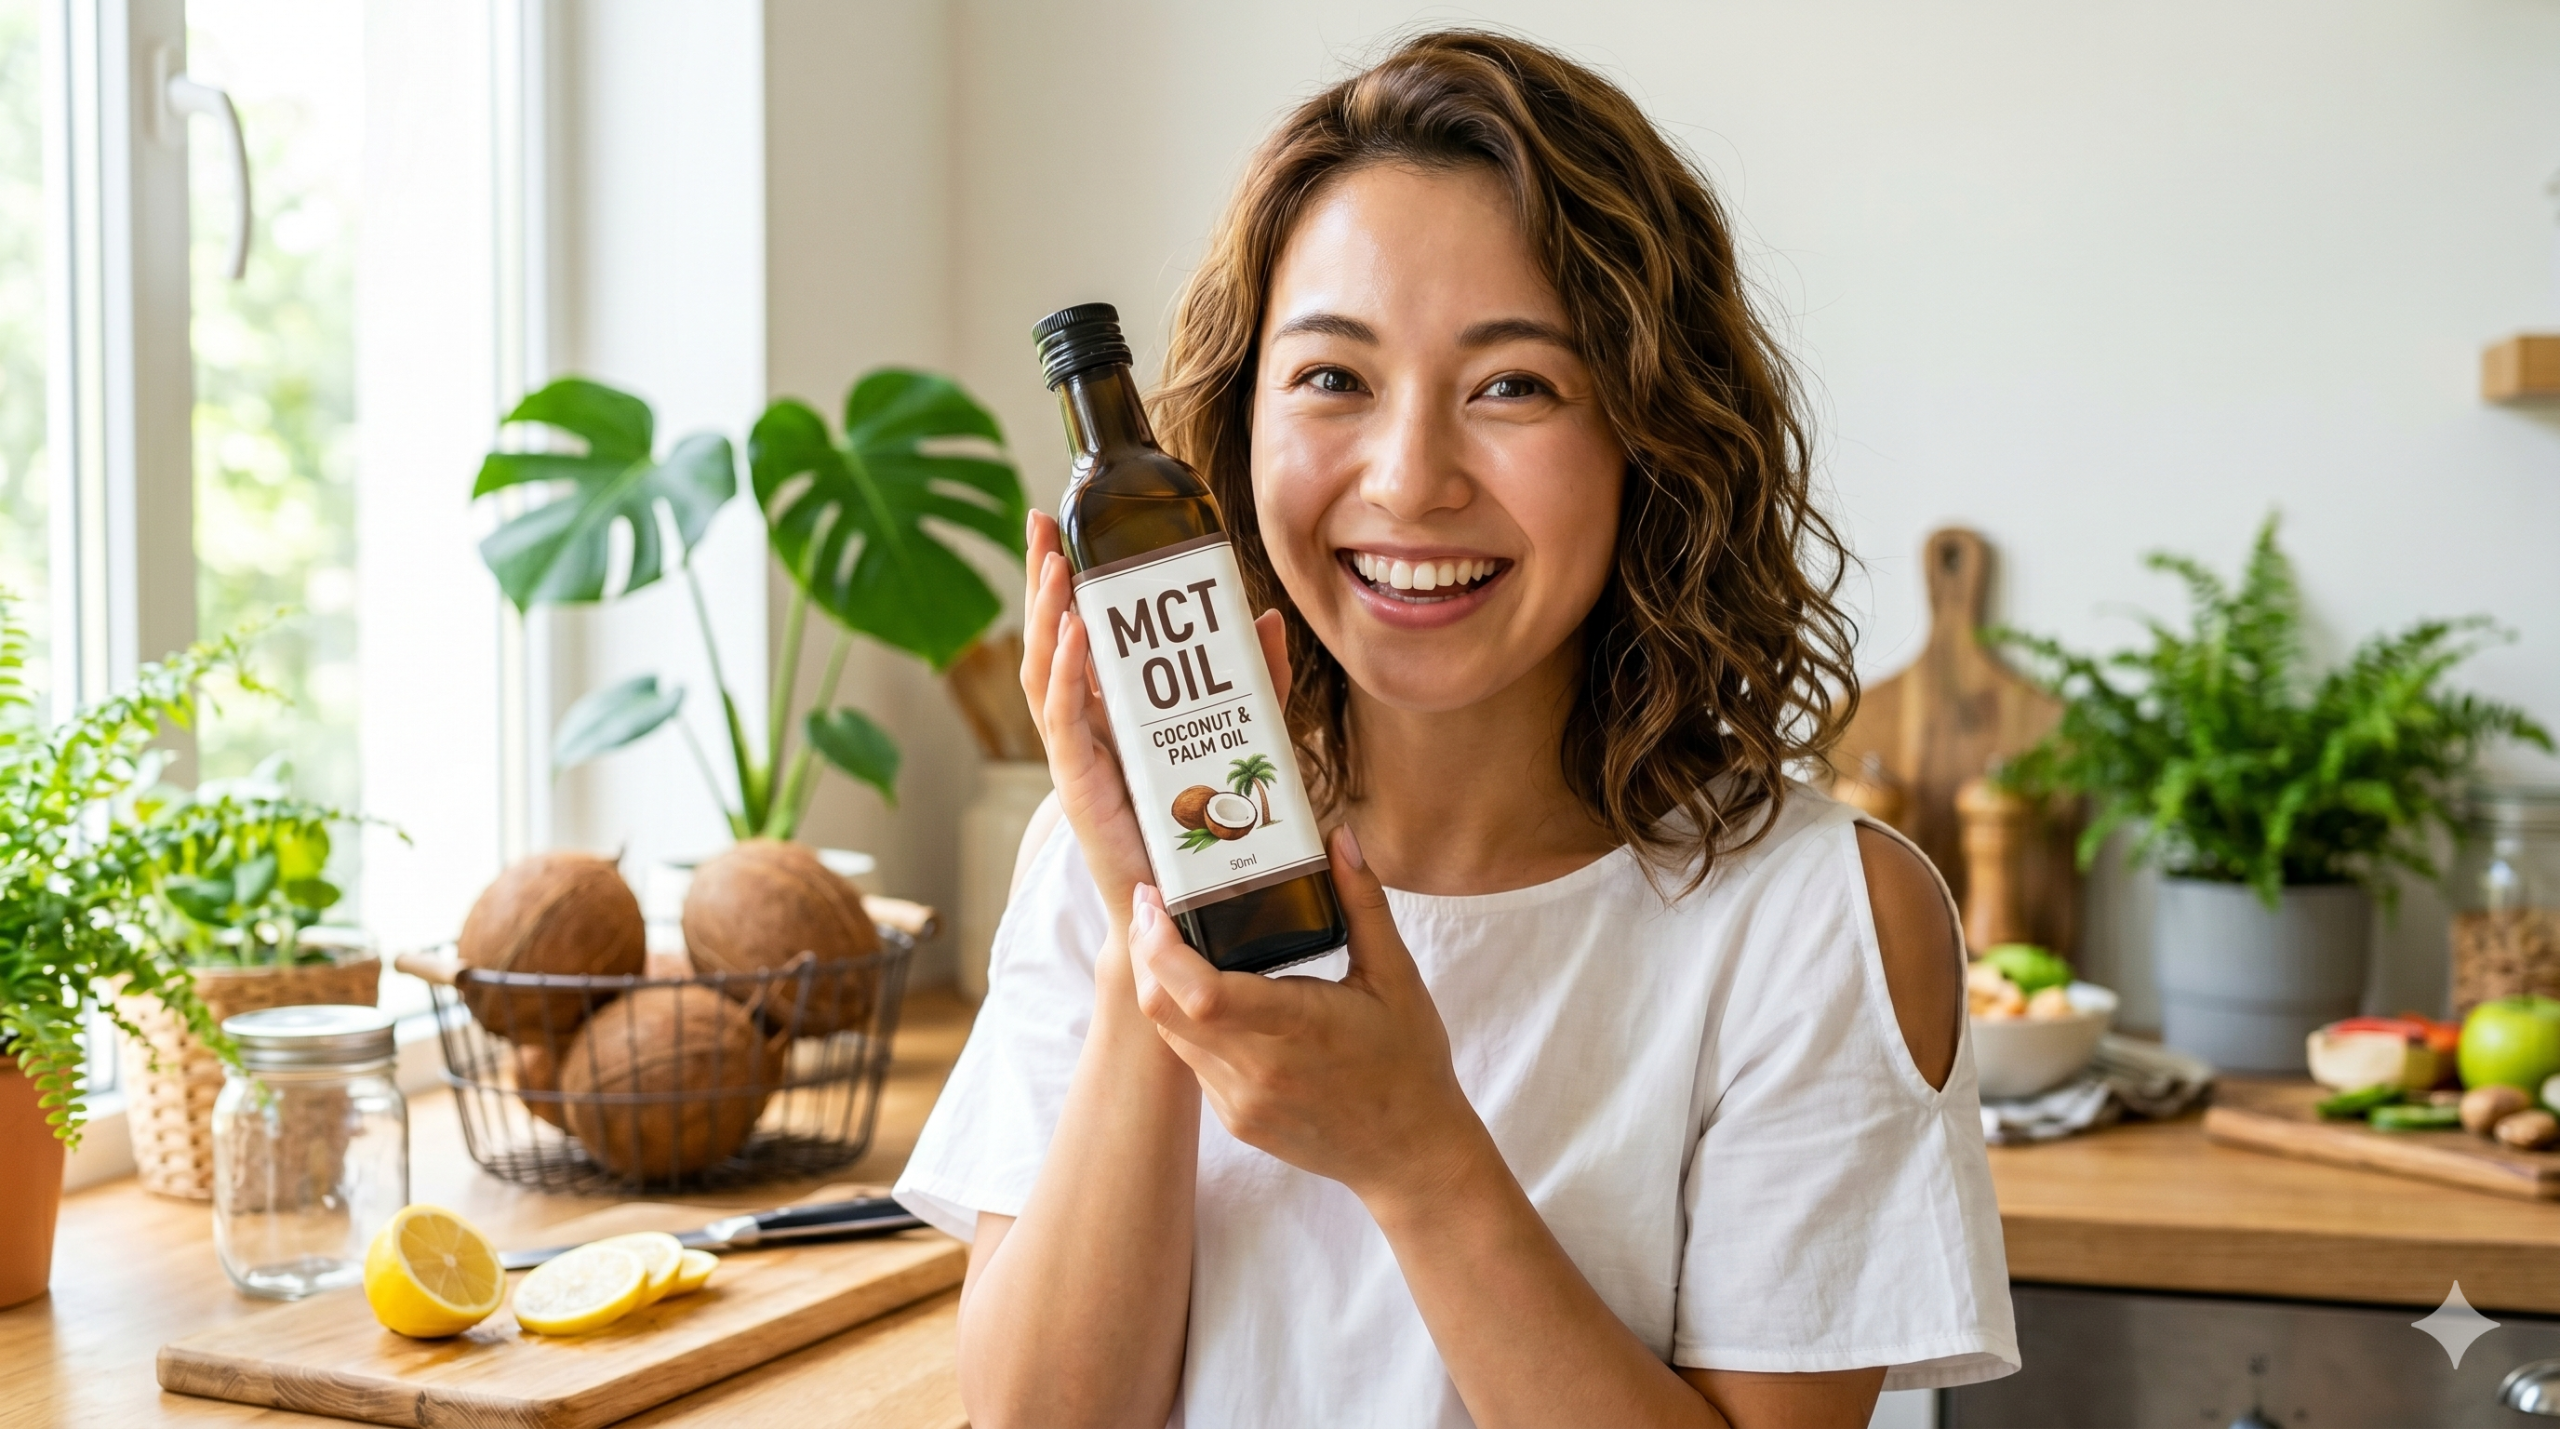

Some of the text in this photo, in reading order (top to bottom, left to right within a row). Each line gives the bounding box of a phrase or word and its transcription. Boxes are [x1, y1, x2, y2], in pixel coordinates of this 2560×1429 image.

[1107, 578, 1220, 659] MCT
[1142, 644, 1234, 710] OIL
[1152, 706, 1252, 748] COCONUT &
[1168, 729, 1249, 766] PALM OIL
[1229, 853, 1258, 871] 50ml
